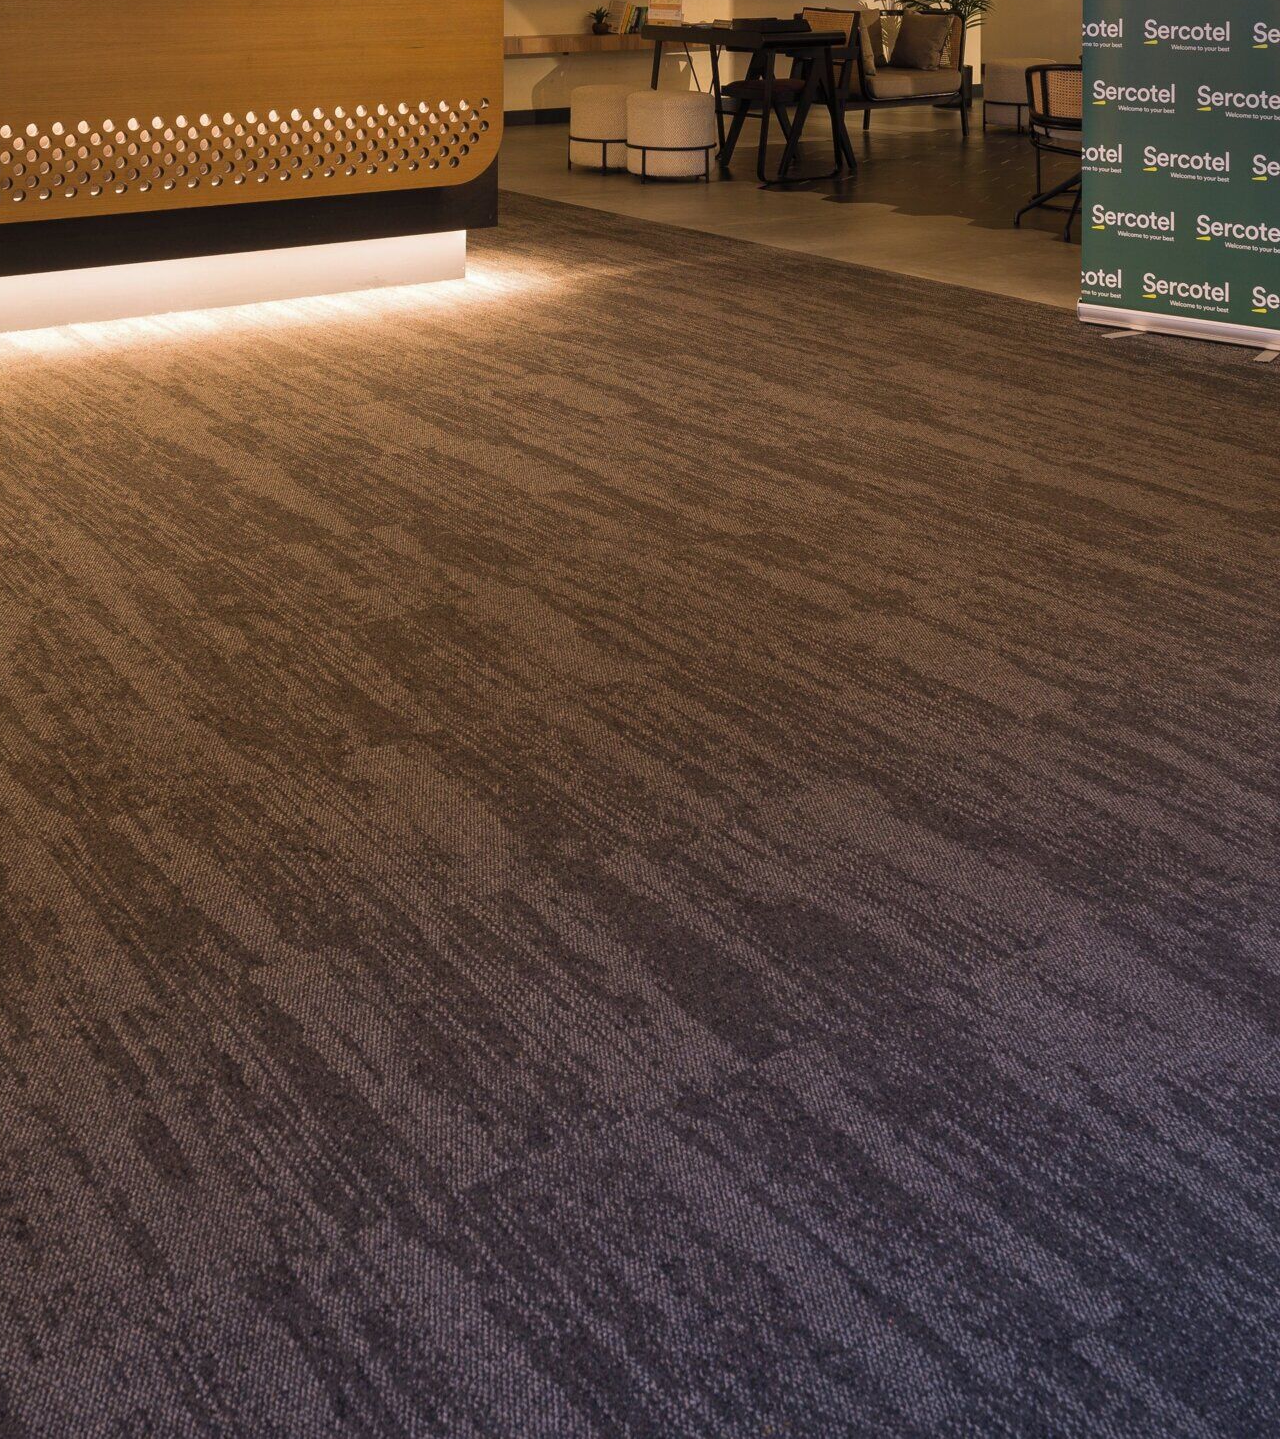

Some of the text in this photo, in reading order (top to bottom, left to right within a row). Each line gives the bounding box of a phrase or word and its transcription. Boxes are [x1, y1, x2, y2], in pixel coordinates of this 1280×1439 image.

[1144, 19, 1230, 42] Sercotel
[1092, 80, 1176, 104] Sercotel
[1225, 111, 1252, 119] Welcome
[1143, 146, 1230, 172] Sercotel
[1170, 172, 1196, 180] Welcome
[1091, 204, 1175, 232] Sercotel
[1117, 230, 1143, 238] Welcome
[1224, 241, 1251, 251] Welcome
[1142, 272, 1229, 303] Sercotel
[1169, 300, 1195, 309] Welcome
